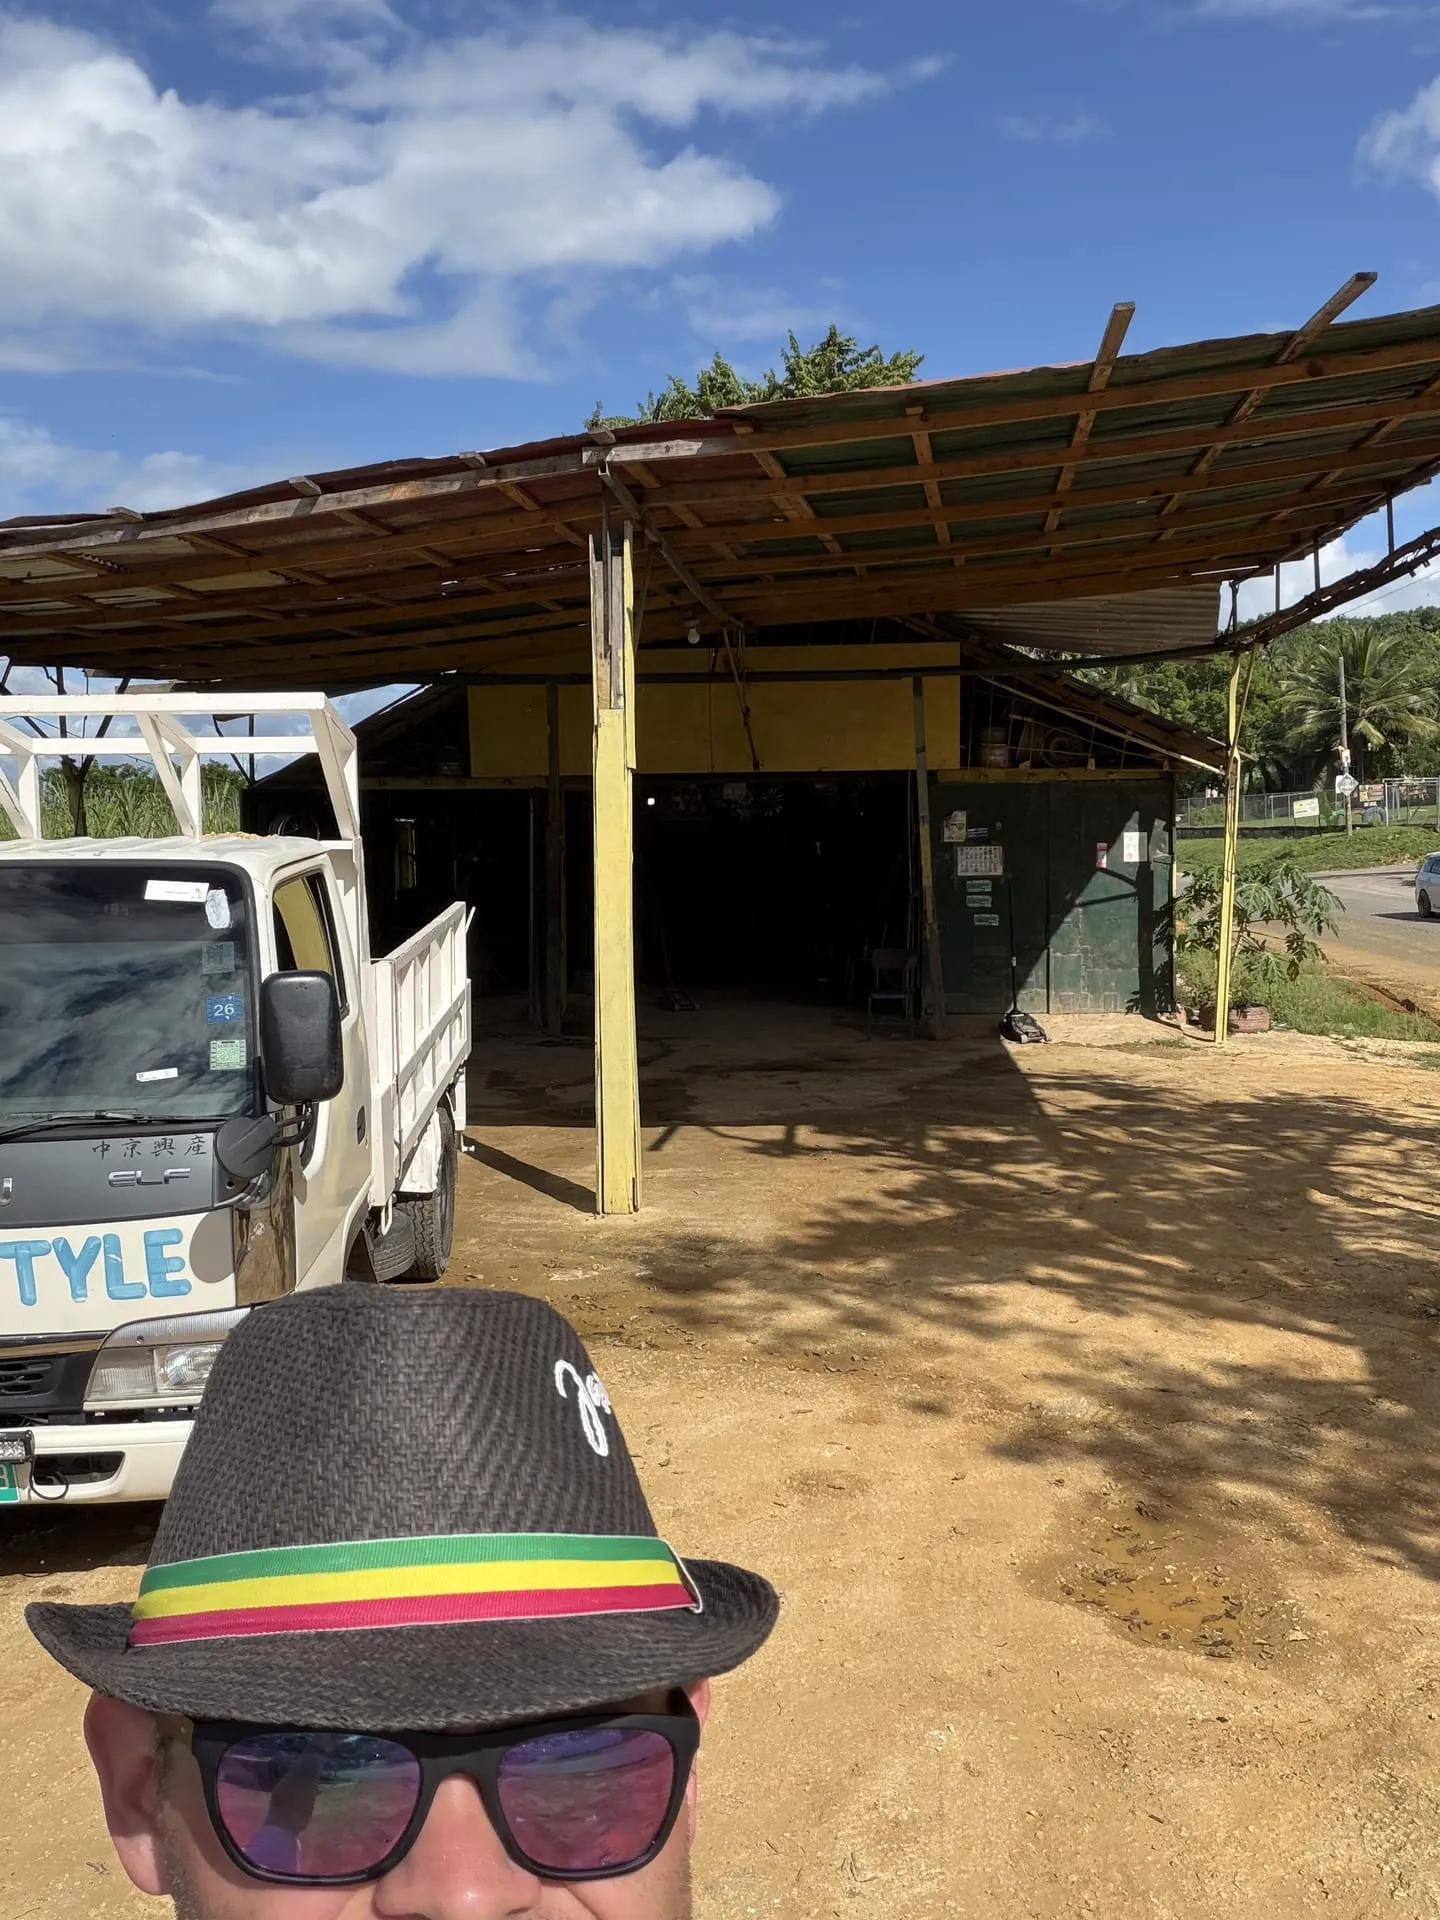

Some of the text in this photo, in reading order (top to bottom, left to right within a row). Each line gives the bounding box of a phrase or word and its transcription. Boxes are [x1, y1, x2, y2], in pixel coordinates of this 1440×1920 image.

[213, 1003, 235, 1017] 26
[108, 1167, 191, 1187] ELF
[0, 1228, 192, 1307] TYLE
